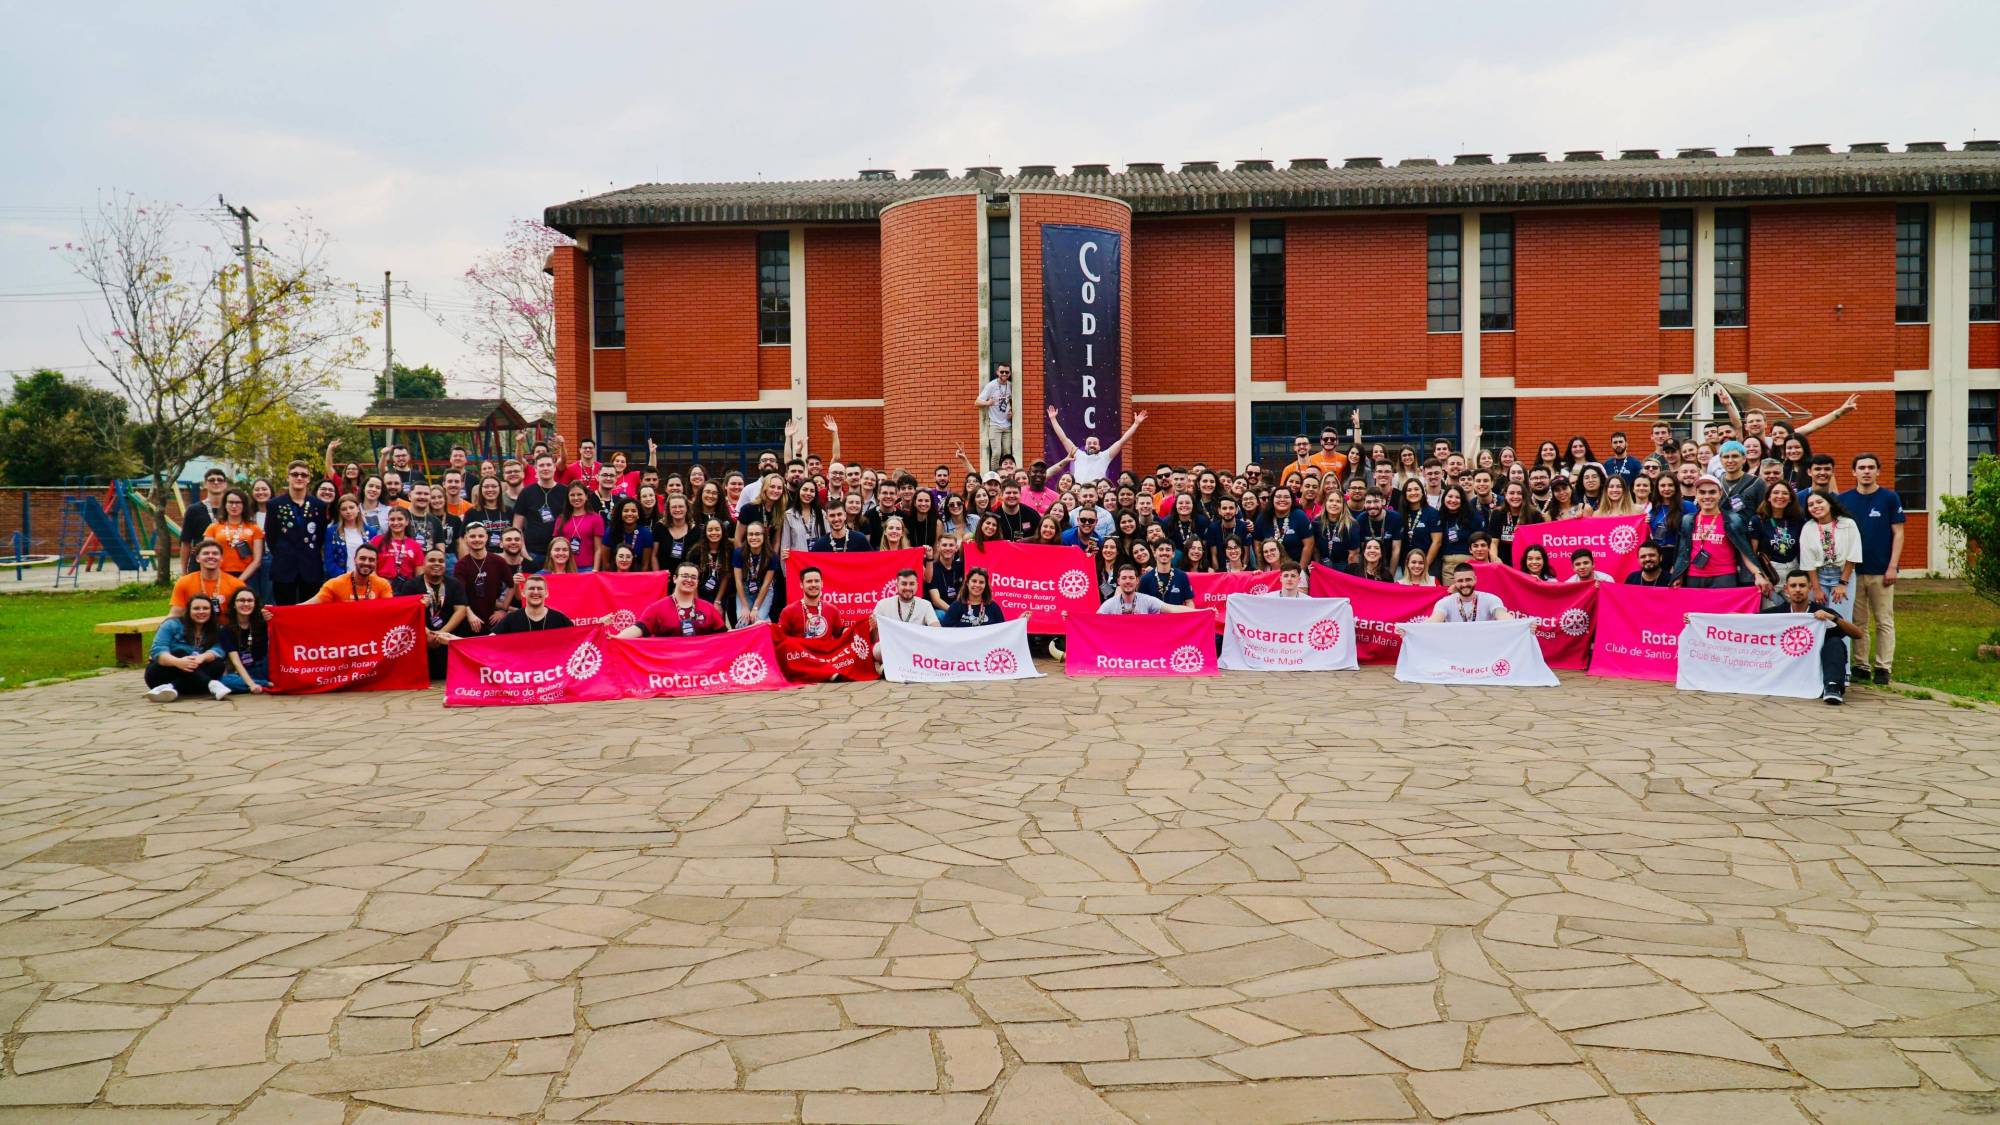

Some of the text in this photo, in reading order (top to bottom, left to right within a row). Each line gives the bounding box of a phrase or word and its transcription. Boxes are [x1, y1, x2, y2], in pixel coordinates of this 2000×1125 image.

[1079, 241, 1101, 429] CODIRC
[1542, 534, 1606, 547] Rotaract
[991, 573, 1055, 591] Rotaract
[1001, 599, 1056, 612] Cerro Largo
[1204, 593, 1227, 602] Rota
[1236, 623, 1304, 644] Rotaract
[1353, 616, 1400, 635] taract
[1373, 634, 1398, 647] Maria
[1535, 630, 1556, 640] zaga
[1641, 630, 1677, 646] Rota
[1706, 626, 1776, 646] Rotaract
[293, 640, 378, 661] Rotaract
[1605, 642, 1627, 654] Club
[1630, 647, 1642, 656] de
[1644, 649, 1672, 659] Santo
[280, 664, 300, 674] lube
[301, 664, 336, 674] parceiro
[351, 660, 378, 669] Rotary
[912, 653, 982, 672] Rotaract
[1097, 655, 1167, 669] Rotaract
[1278, 657, 1303, 665] Maio
[316, 674, 348, 686] Santa
[480, 665, 564, 684] Rotaract
[648, 671, 728, 689] Rotaract
[455, 687, 481, 697] Clube
[522, 687, 534, 696] do
